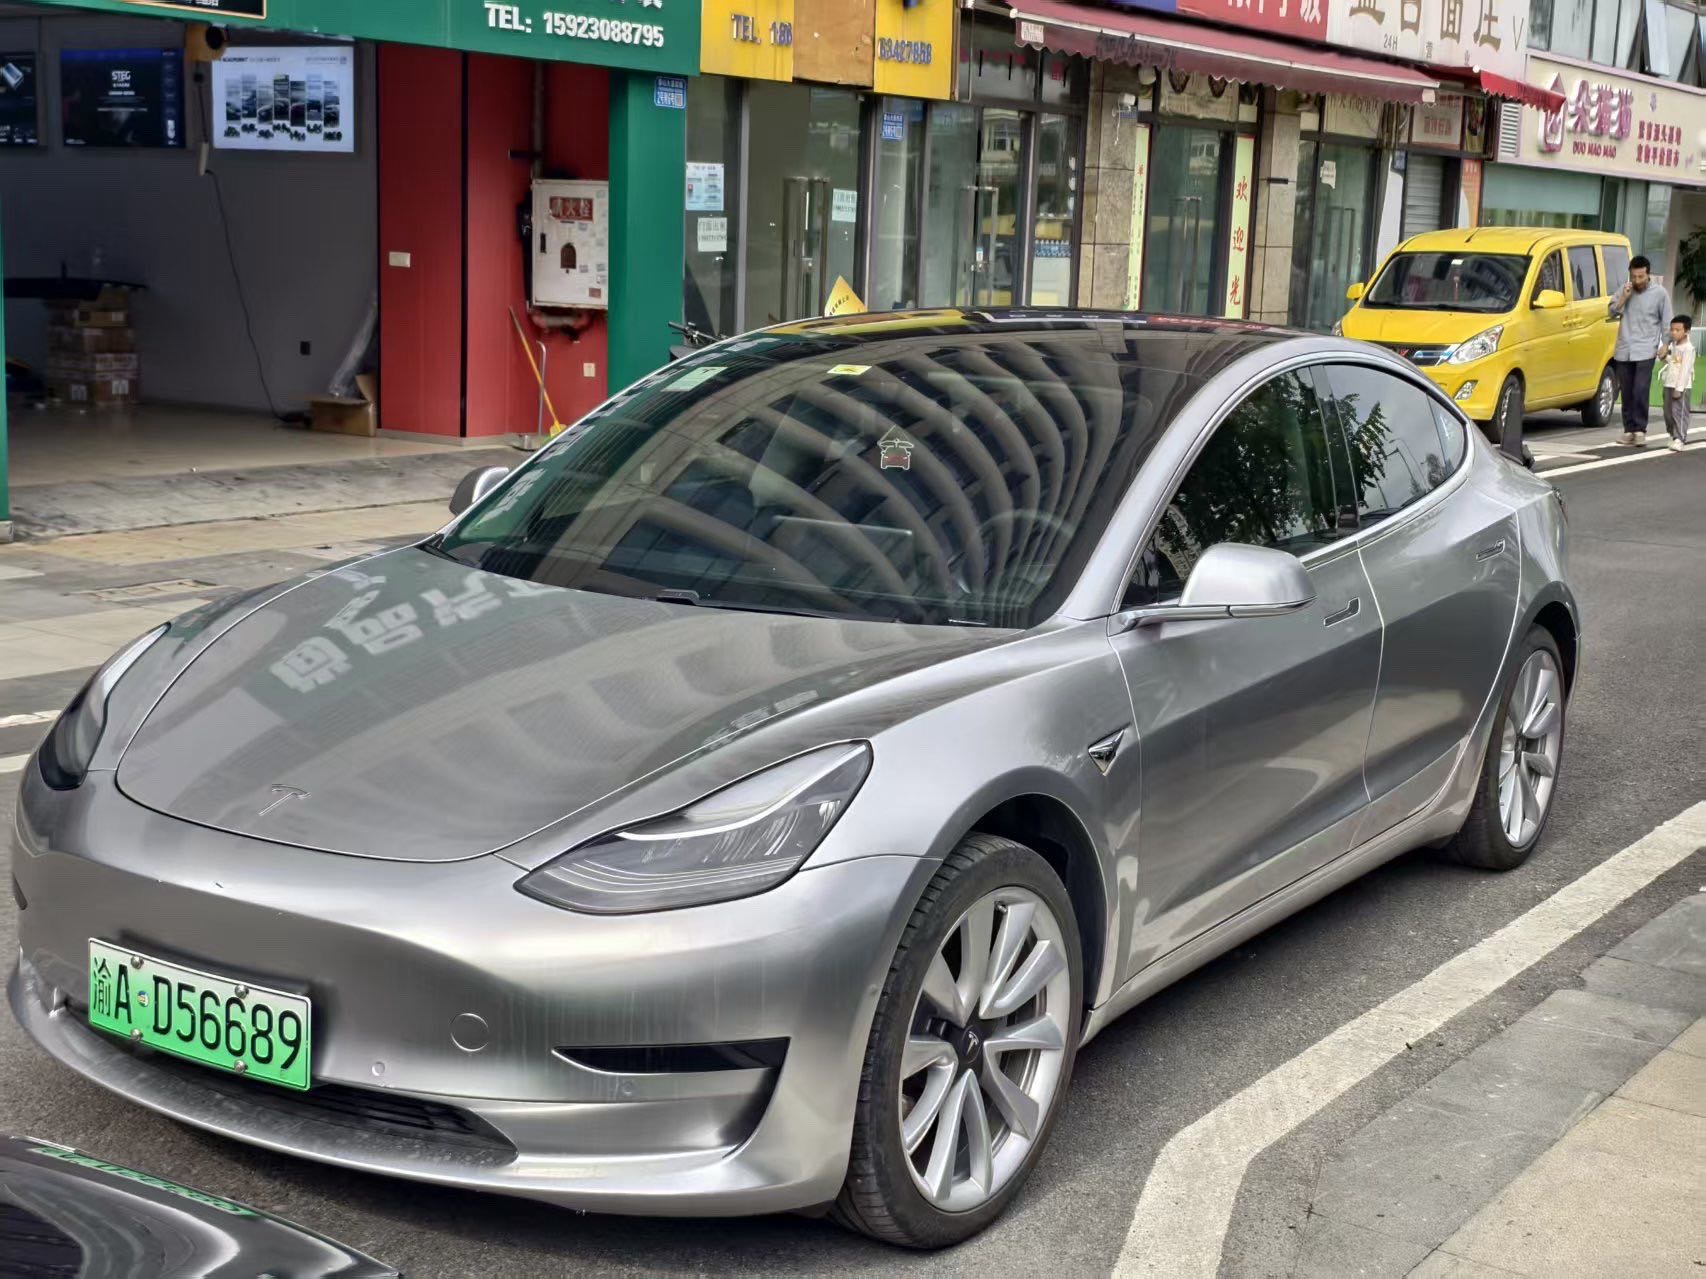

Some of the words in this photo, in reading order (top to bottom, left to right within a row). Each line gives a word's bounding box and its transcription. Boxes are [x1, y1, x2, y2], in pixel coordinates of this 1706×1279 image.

[484, 2, 532, 34] TEL:
[543, 11, 665, 48] 15923088795
[1384, 34, 1398, 50] 24H
